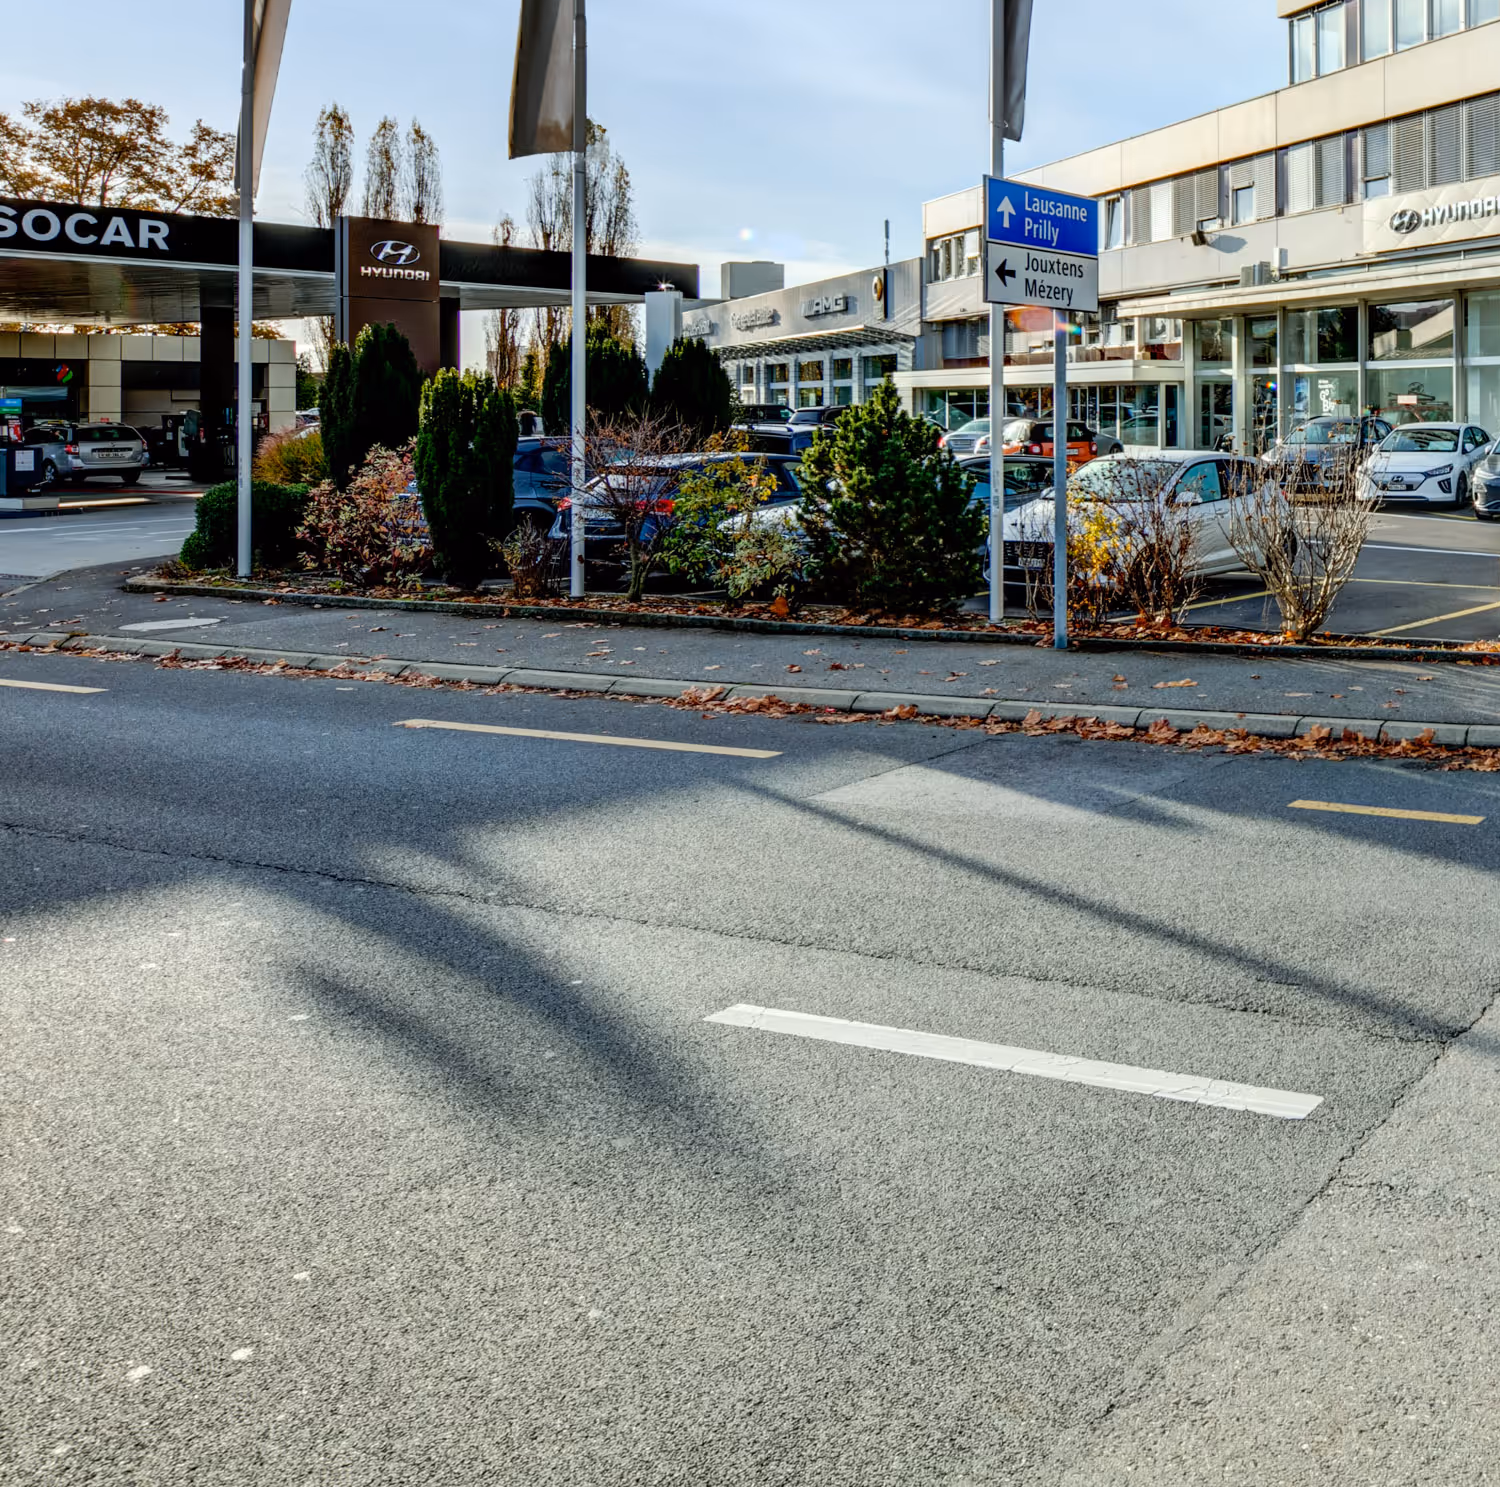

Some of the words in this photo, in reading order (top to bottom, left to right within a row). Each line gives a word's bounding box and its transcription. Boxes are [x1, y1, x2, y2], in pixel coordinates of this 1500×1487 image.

[1024, 191, 1088, 223] Lausanne
[1024, 217, 1060, 247] Prilly
[360, 265, 431, 281] HYUNDAI
[1024, 252, 1084, 279] Jouxtens
[1024, 277, 1074, 307] Mézery
